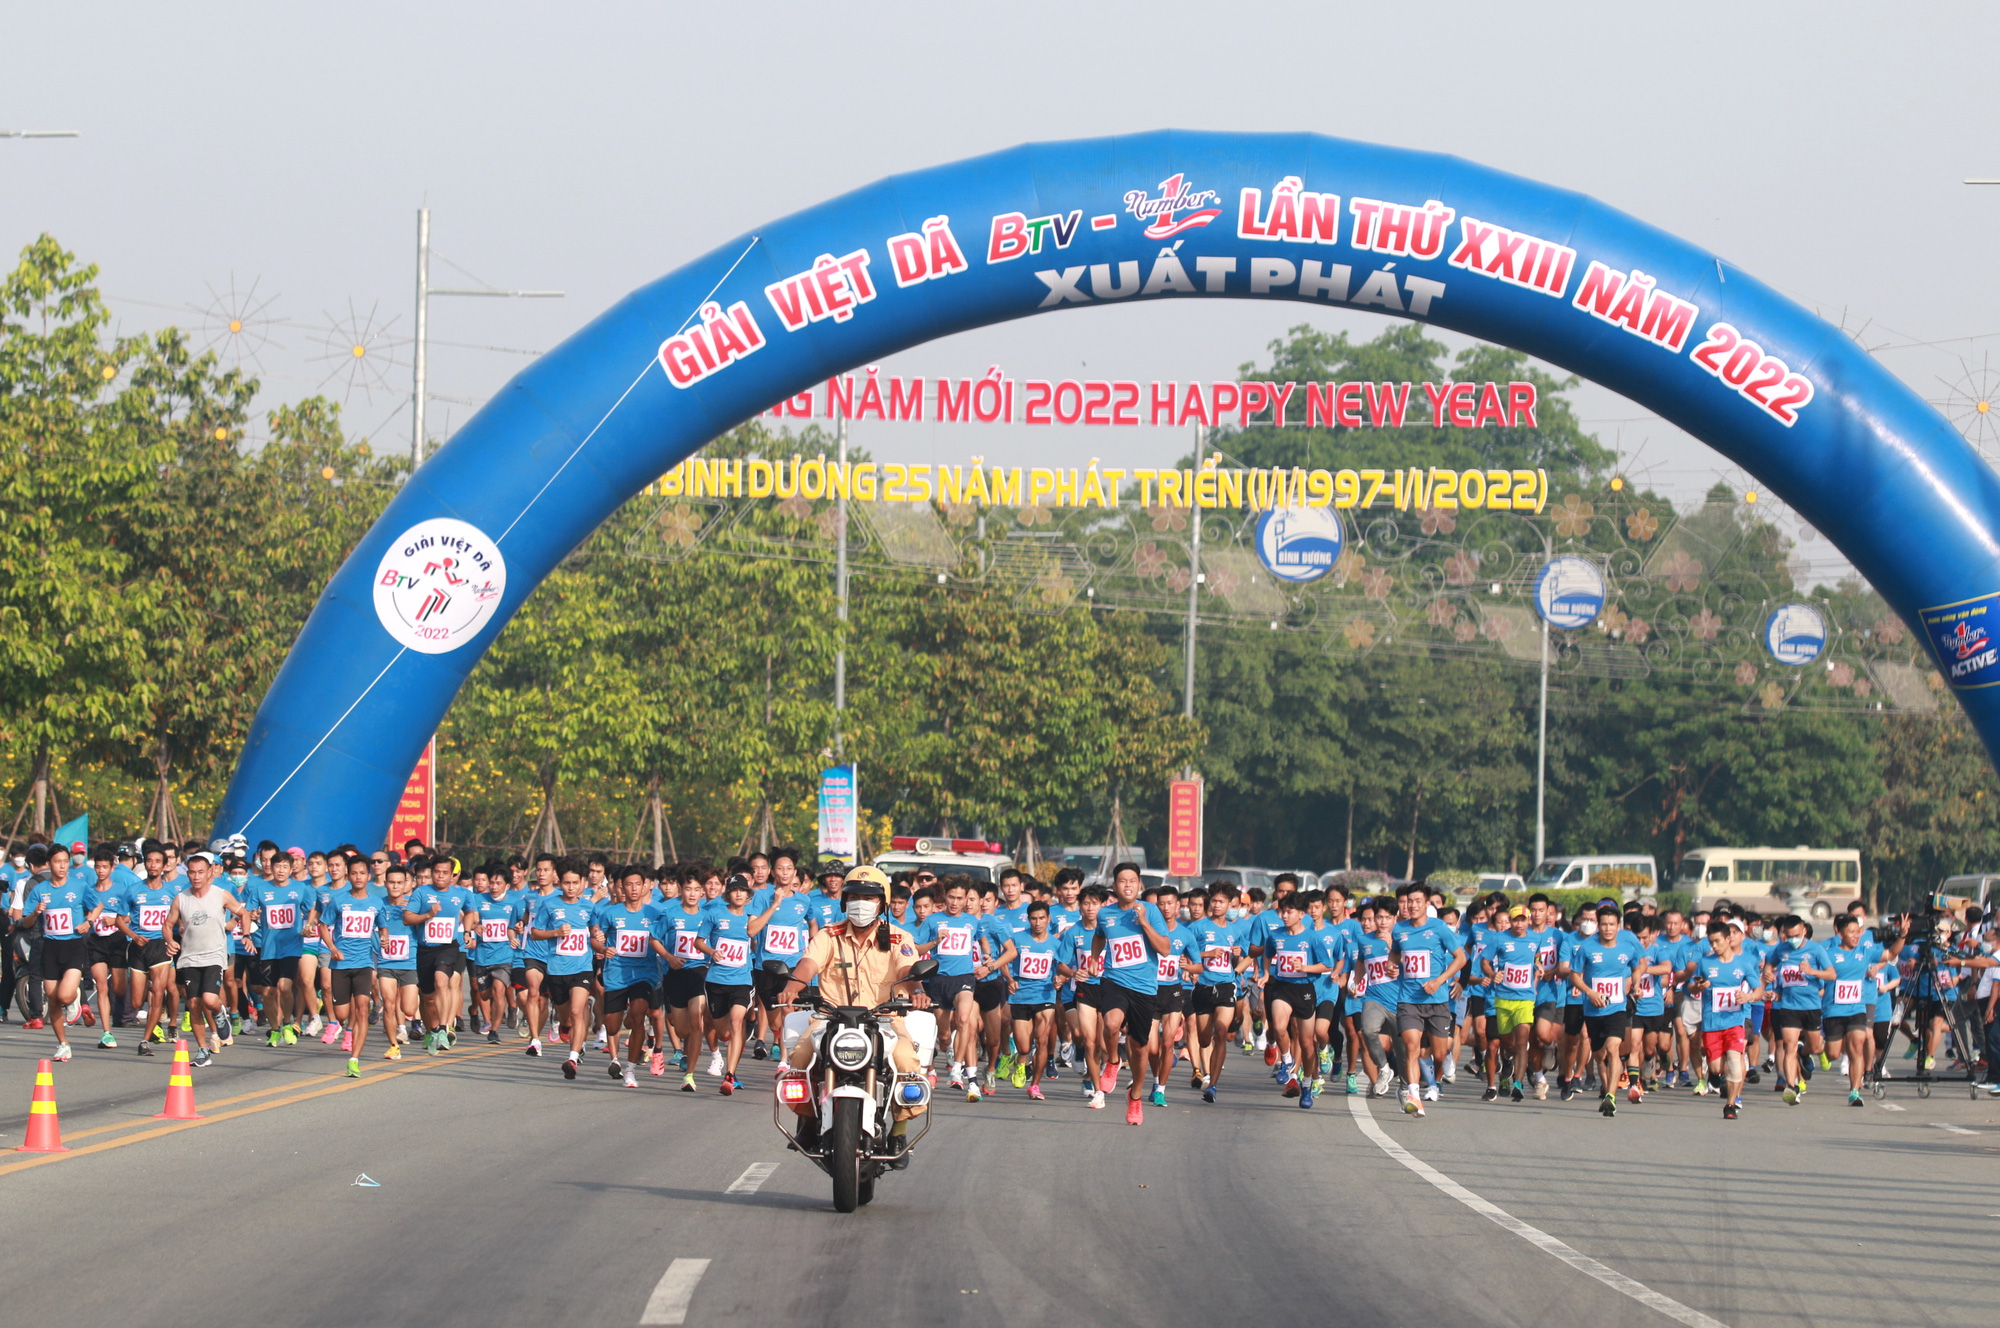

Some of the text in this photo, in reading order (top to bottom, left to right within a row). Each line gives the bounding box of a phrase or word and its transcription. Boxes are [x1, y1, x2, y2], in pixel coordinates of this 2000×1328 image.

[1035, 240, 1446, 315] XUẤT PHÁT
[658, 300, 766, 389] GIẢI
[765, 246, 877, 331] VIỆT
[887, 215, 967, 287] DÃ
[987, 210, 1082, 263] BTV
[1124, 181, 1217, 220] Number
[1237, 176, 1341, 244] LẦN
[1349, 199, 1455, 260] THỨ
[1449, 217, 1576, 298] XXIII
[1573, 261, 1699, 352] NĂM
[1690, 322, 1814, 428] 2022
[826, 365, 924, 421] NĂM
[937, 365, 1014, 424] MỚI
[1025, 380, 1140, 426] 2022
[1151, 381, 1296, 428] HAPPY
[1306, 381, 1412, 428] NEW
[1422, 381, 1538, 428] YEAR
[749, 454, 877, 501] DƯƠNG
[883, 462, 931, 502] 25
[937, 456, 1021, 507] NĂM
[1030, 457, 1126, 508] PHÁT
[1134, 452, 1243, 508] TRIỂN
[404, 535, 493, 572] GIẢI VIỆT DÃ
[380, 570, 420, 589] BTV
[415, 624, 449, 640] 2022
[1952, 648, 1997, 678] ACTIVE
[46, 913, 69, 930] 212
[143, 910, 167, 926] 226
[270, 908, 293, 925] 680
[346, 916, 371, 933] 230
[428, 922, 453, 938] 666
[486, 923, 506, 938] 879
[561, 934, 584, 951] 238
[621, 935, 645, 952] 291
[678, 936, 703, 954] 21
[769, 930, 796, 949] 242
[942, 933, 968, 950] 267
[720, 943, 743, 962] 244
[1114, 940, 1142, 962] 296
[1023, 957, 1049, 974] 239
[1405, 955, 1426, 973] 231
[1507, 968, 1529, 984] 585
[1597, 982, 1619, 997] 691
[1838, 985, 1859, 999] 874
